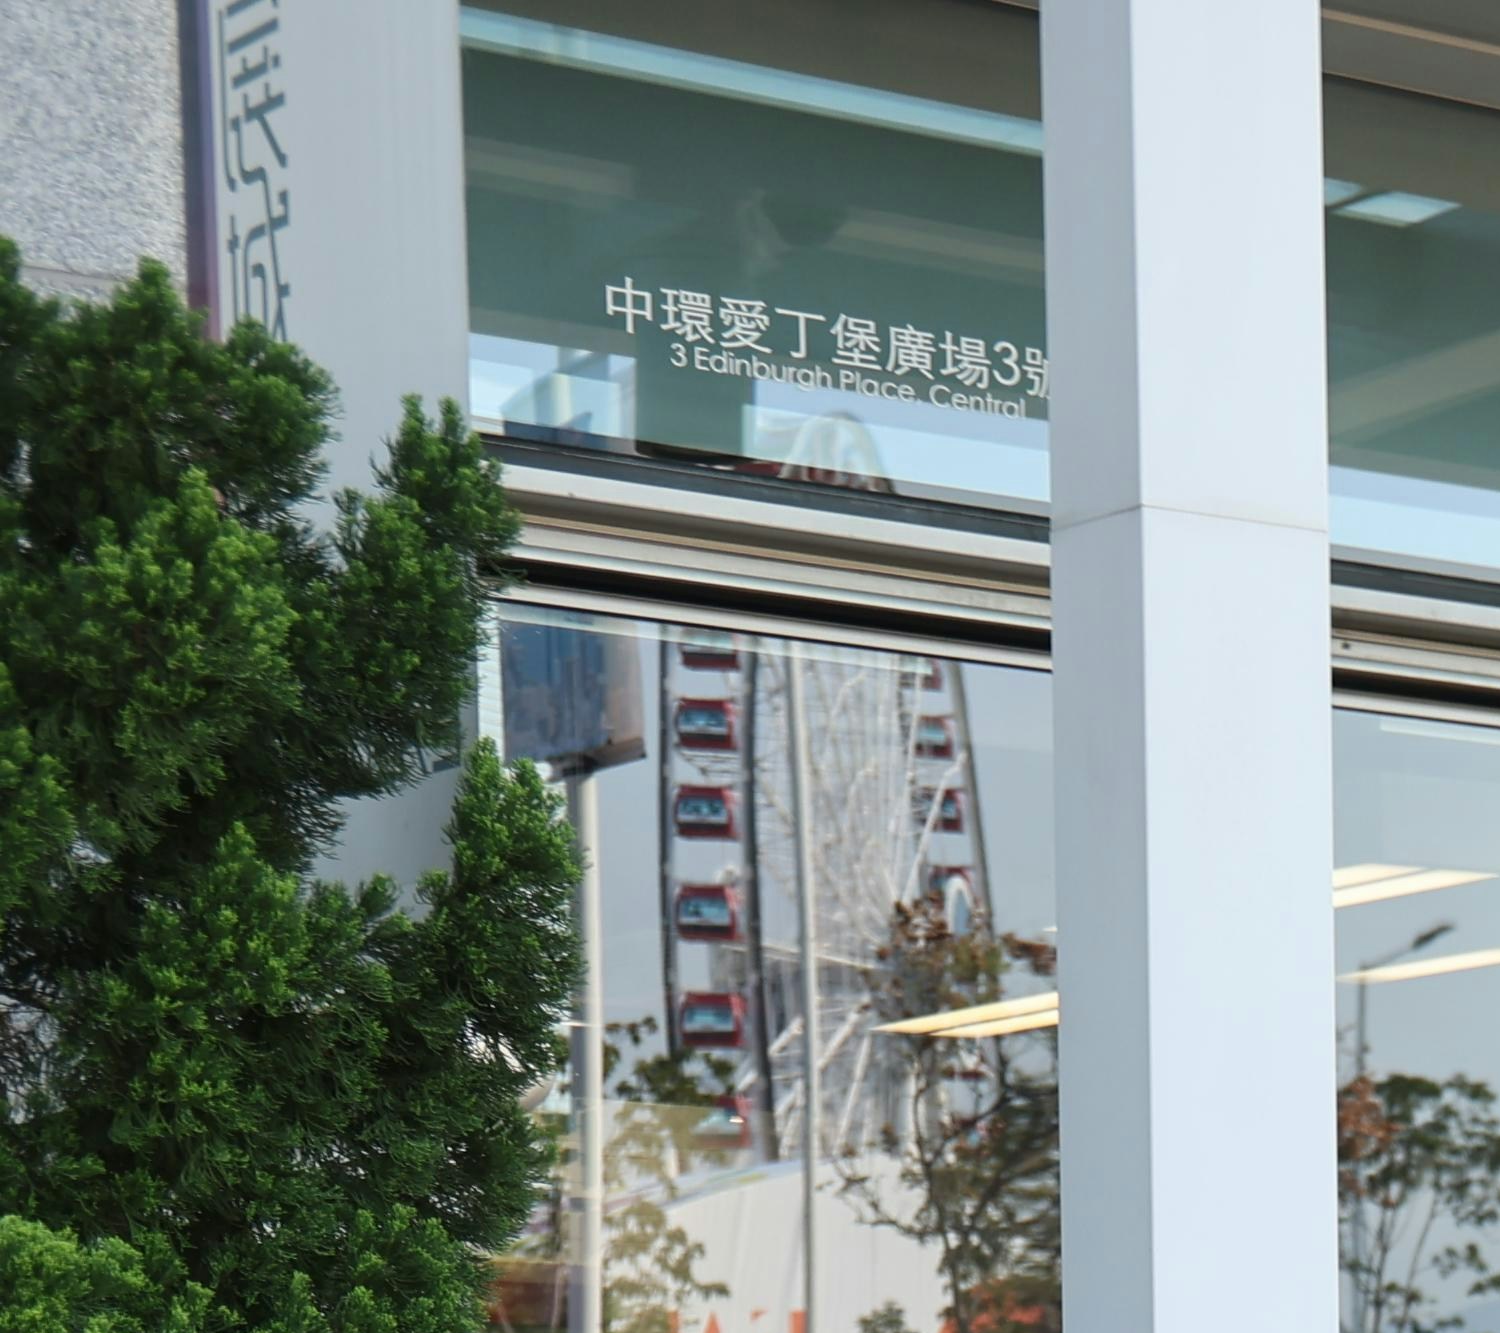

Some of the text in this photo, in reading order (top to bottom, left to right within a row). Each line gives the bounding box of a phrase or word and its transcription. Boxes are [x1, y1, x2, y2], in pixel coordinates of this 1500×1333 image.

[669, 343, 688, 367] 3
[694, 347, 832, 391] Edinburgh
[930, 384, 1026, 420] Central
